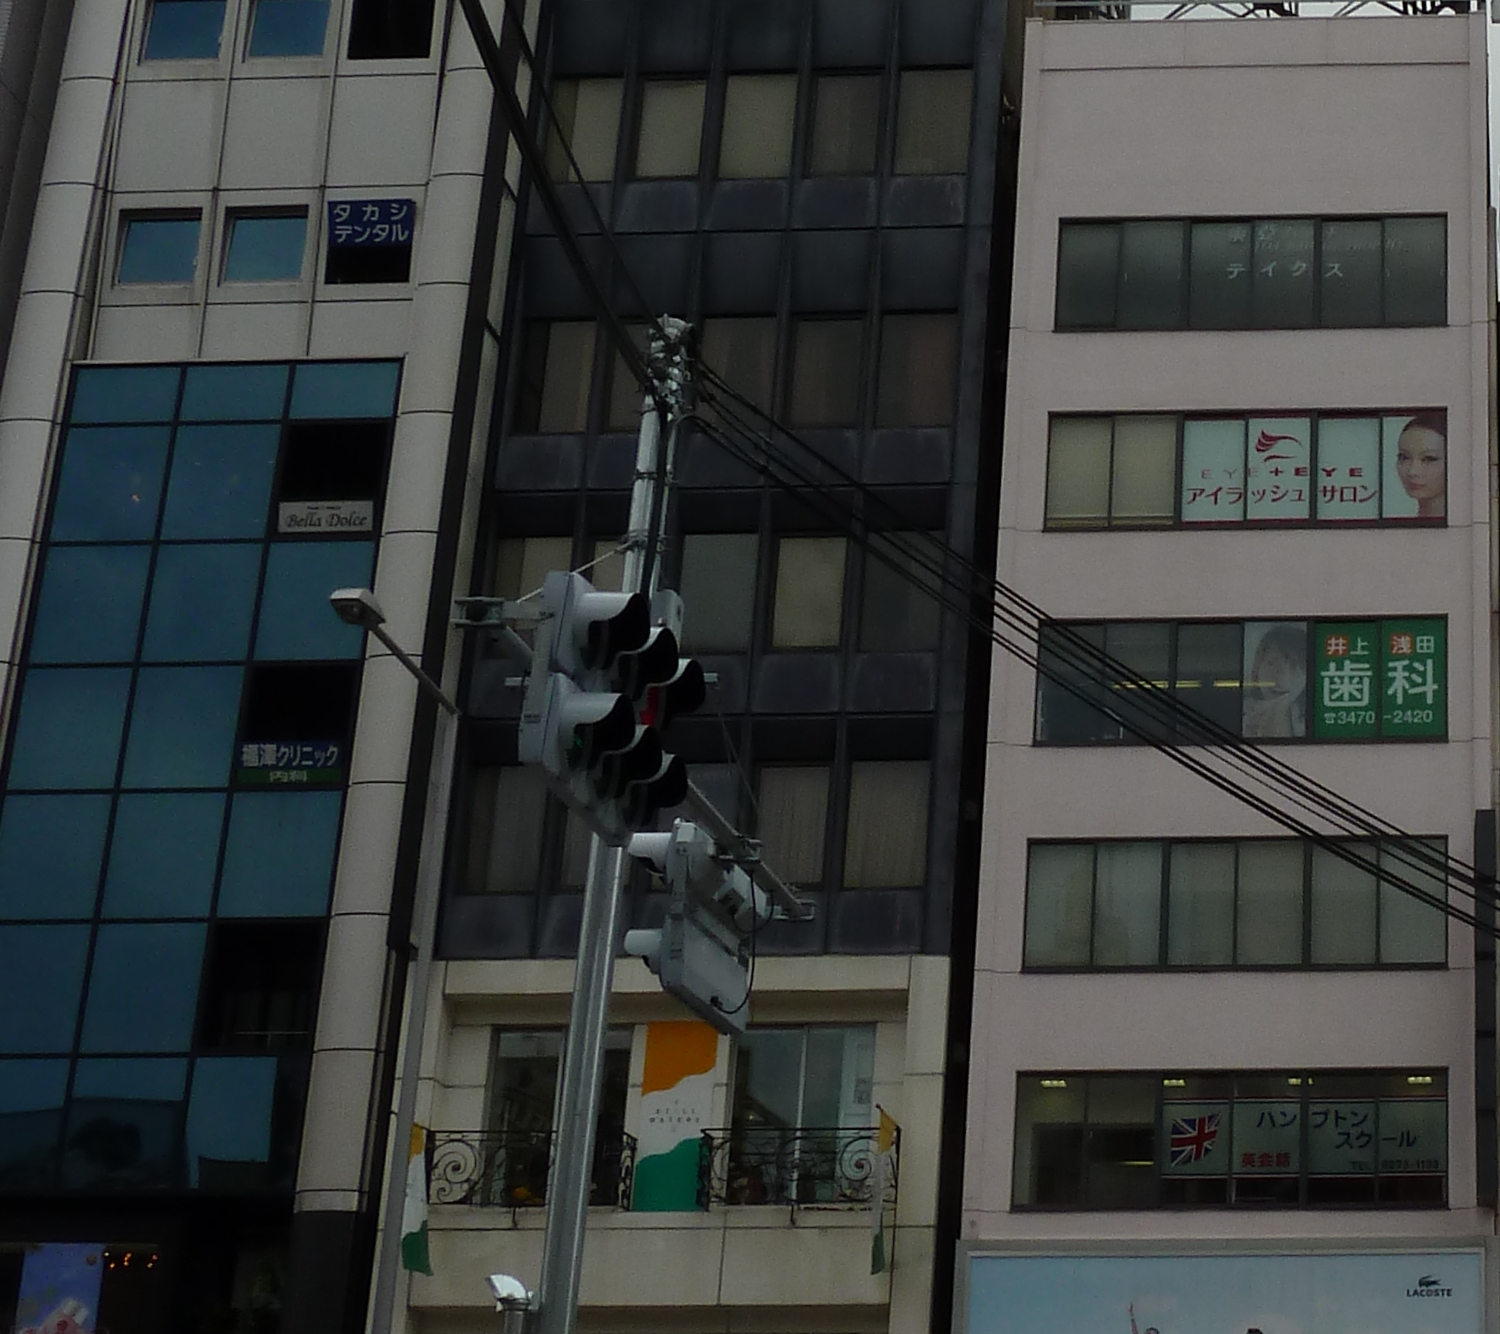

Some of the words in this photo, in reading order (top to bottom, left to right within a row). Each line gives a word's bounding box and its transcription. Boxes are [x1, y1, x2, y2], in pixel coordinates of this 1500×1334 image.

[333, 203, 408, 224] タカシ
[327, 510, 368, 527] Dolce
[1325, 635, 1371, 656] 井上
[1320, 658, 1440, 707] 歯科
[1334, 1130, 1417, 1149] スクール
[1406, 1288, 1453, 1298] LACOSTE
